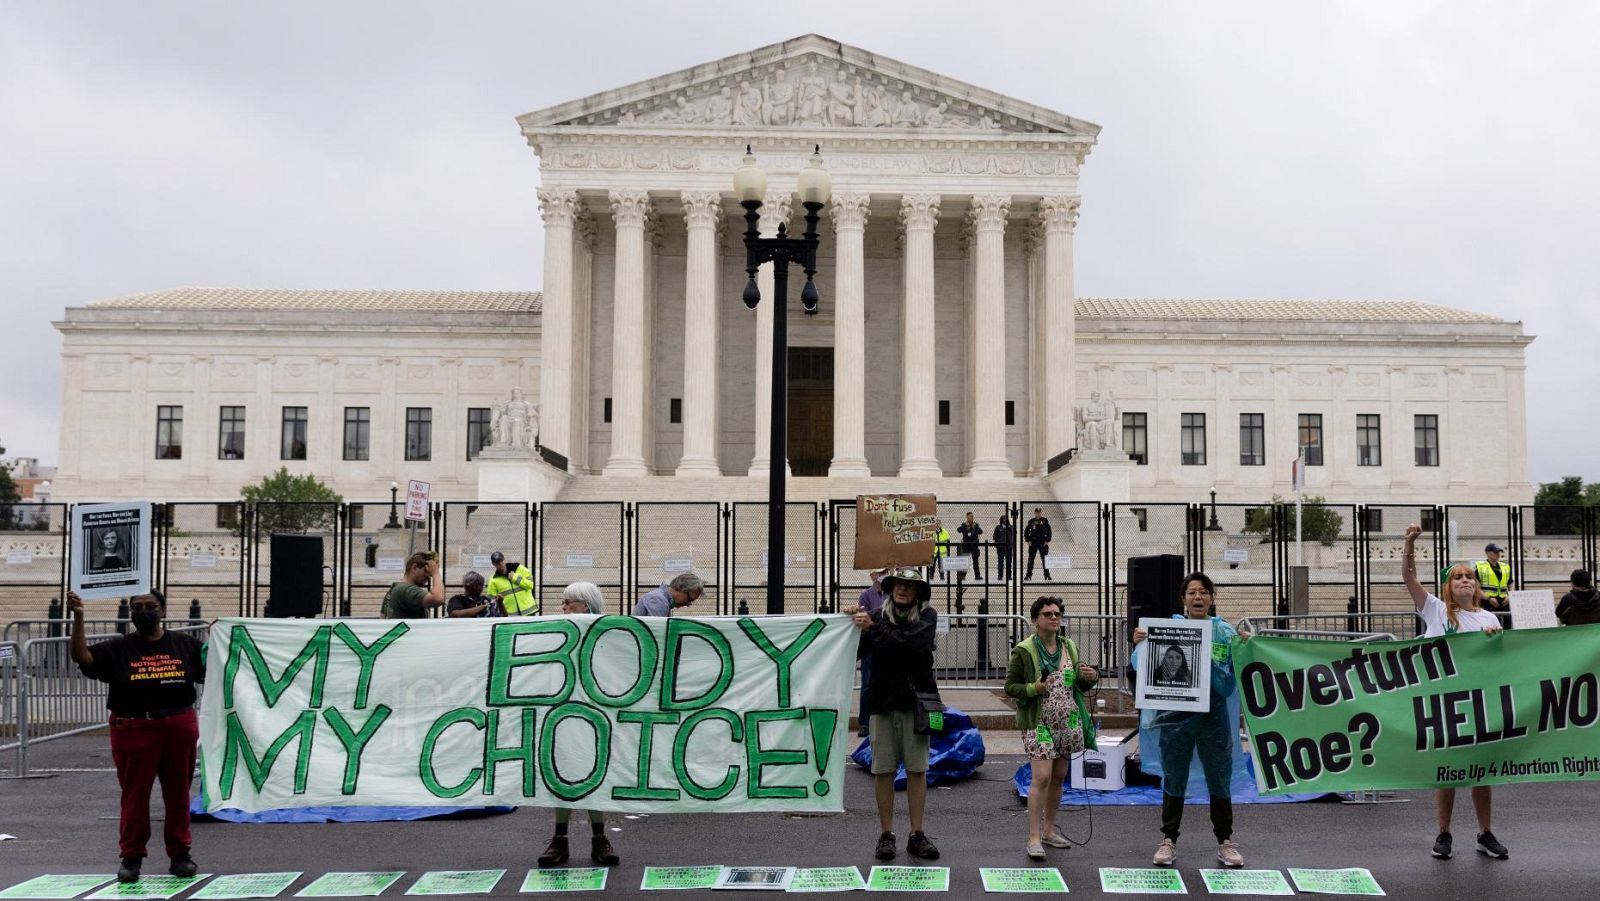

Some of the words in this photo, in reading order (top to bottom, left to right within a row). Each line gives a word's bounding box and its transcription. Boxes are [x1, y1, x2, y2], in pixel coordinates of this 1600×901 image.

[866, 499, 889, 512] Don't
[892, 499, 913, 512] fuse
[130, 671, 185, 681] ENSLAVEMENT
[131, 659, 182, 668] MOTHERHOOD
[224, 621, 410, 711] MY
[487, 614, 827, 711] BODY
[1241, 638, 1458, 718] Overturn
[1255, 712, 1382, 790] Roe?
[1412, 684, 1529, 752] HELL
[1538, 672, 1600, 734] NO
[221, 703, 393, 801] MY
[419, 702, 839, 801] CHOICE!
[1437, 765, 1466, 782] Rise
[1469, 764, 1486, 782] Up
[1488, 762, 1498, 777] 4
[1500, 758, 1560, 777] Abortion
[1562, 756, 1600, 777] Right
